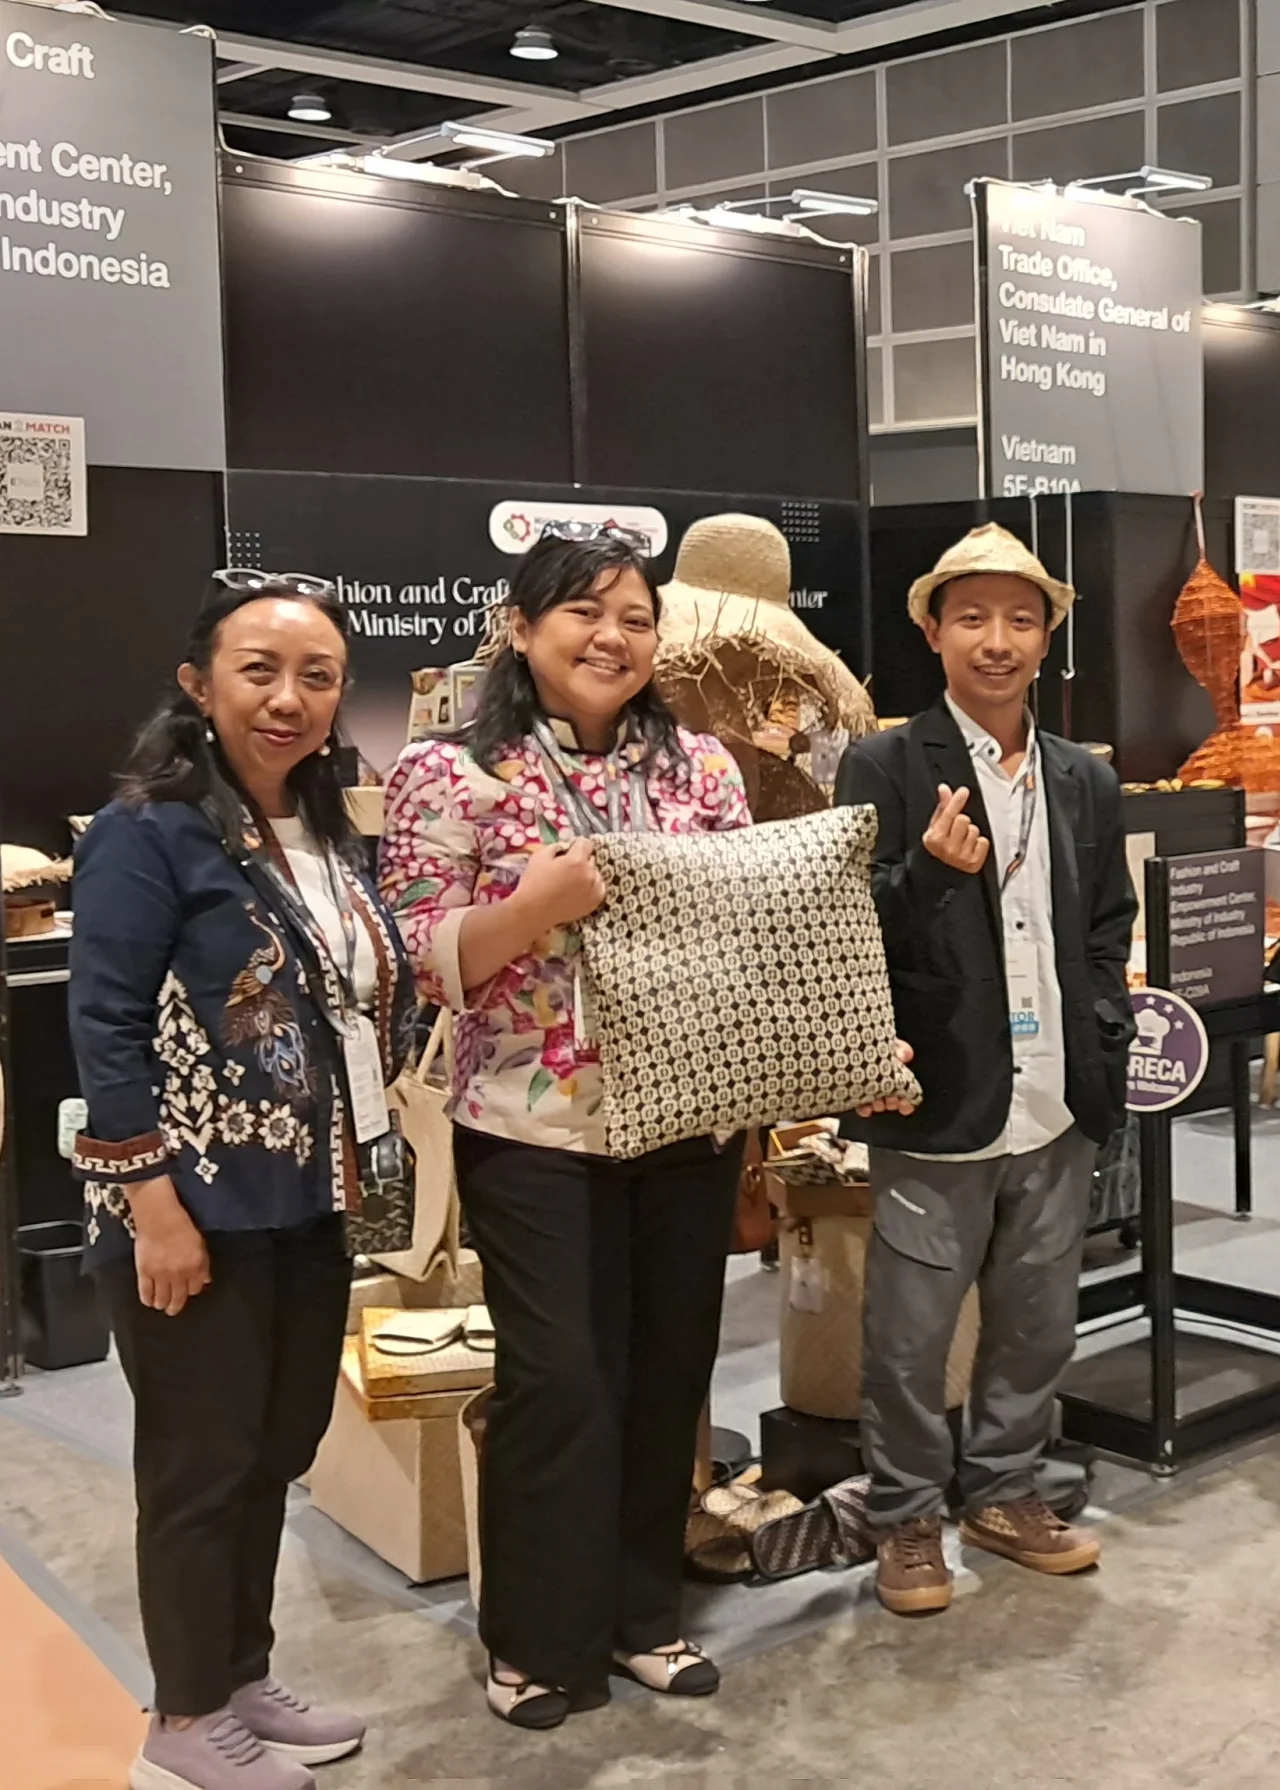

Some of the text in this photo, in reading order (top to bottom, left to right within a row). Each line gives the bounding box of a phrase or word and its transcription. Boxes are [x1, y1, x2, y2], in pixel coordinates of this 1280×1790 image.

[6, 31, 95, 79] Craft
[0, 139, 172, 196] nt Center,
[1039, 214, 1085, 247] Nam
[1, 236, 170, 288] Indonesia
[998, 244, 1118, 292] Trade Office,
[998, 281, 1192, 333] Consulate General of
[998, 317, 1107, 357] Viet Nam in
[1001, 354, 1106, 397] Hong Kong
[25, 421, 71, 434] MATCH
[1001, 433, 1077, 466] Vietnam
[399, 576, 447, 604] and
[348, 609, 447, 645] Ministry
[453, 609, 477, 637] of
[1170, 859, 1240, 880] Fashion and Craft
[1170, 883, 1204, 897] Industry
[1170, 895, 1228, 915] Empowerment
[1170, 909, 1246, 931] Ministry of Industry
[1207, 928, 1217, 942] of
[1217, 923, 1256, 939] Indonesia
[1170, 966, 1213, 984] Indonesia
[1127, 1055, 1187, 1083] RECA
